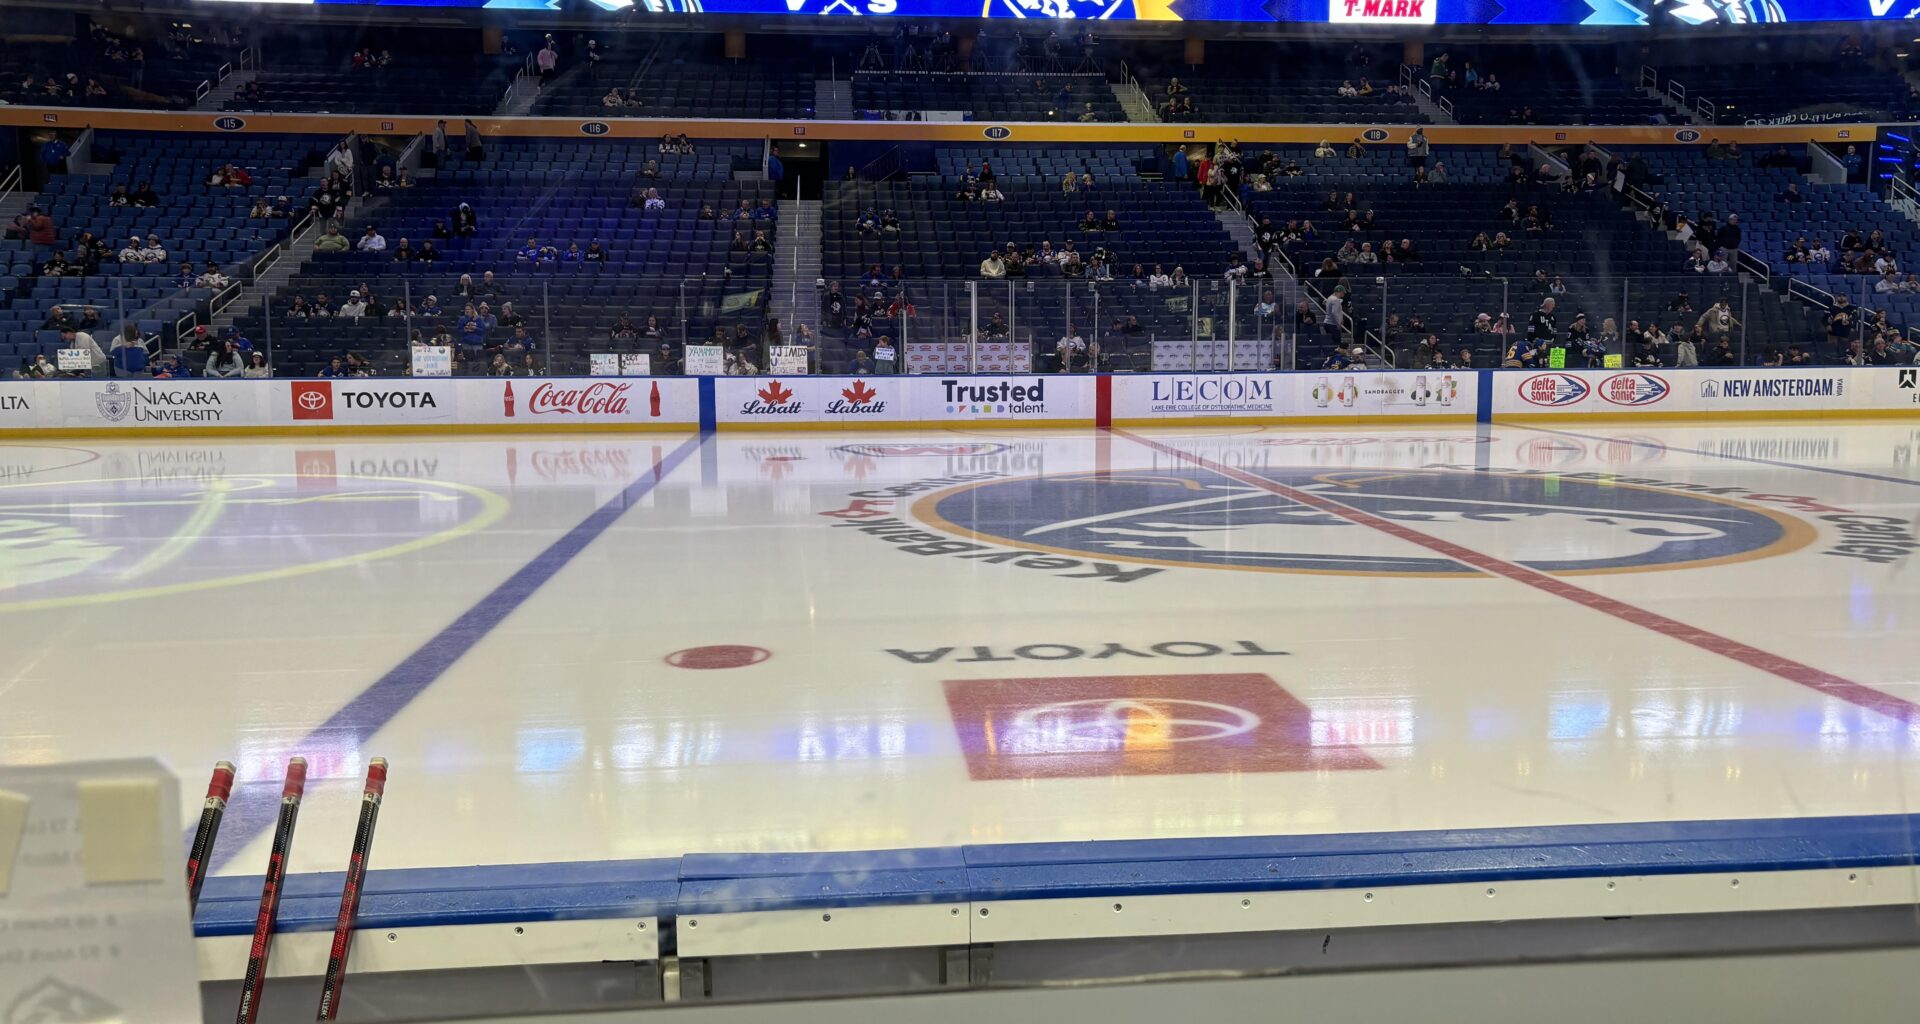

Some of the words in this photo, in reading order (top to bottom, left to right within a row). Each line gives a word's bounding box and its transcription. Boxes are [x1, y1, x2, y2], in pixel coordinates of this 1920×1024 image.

[1344, 0, 1425, 18] T-MARK
[941, 378, 1044, 403] Trusted
[1530, 377, 1556, 391] delta
[1610, 377, 1636, 390] delta
[1723, 379, 1752, 398] NEW
[1752, 378, 1834, 397] AMSTERDAM
[133, 387, 222, 405] NIAGARA
[341, 391, 437, 408] TOYOTA
[529, 382, 633, 415] Coca-Cola
[1530, 390, 1556, 402] sonic
[1610, 390, 1636, 401] sonic
[134, 405, 223, 422] UNIVERSITY
[740, 399, 802, 414] Labatt
[824, 399, 885, 414] Labatt
[885, 640, 1292, 664] TOYOTA
